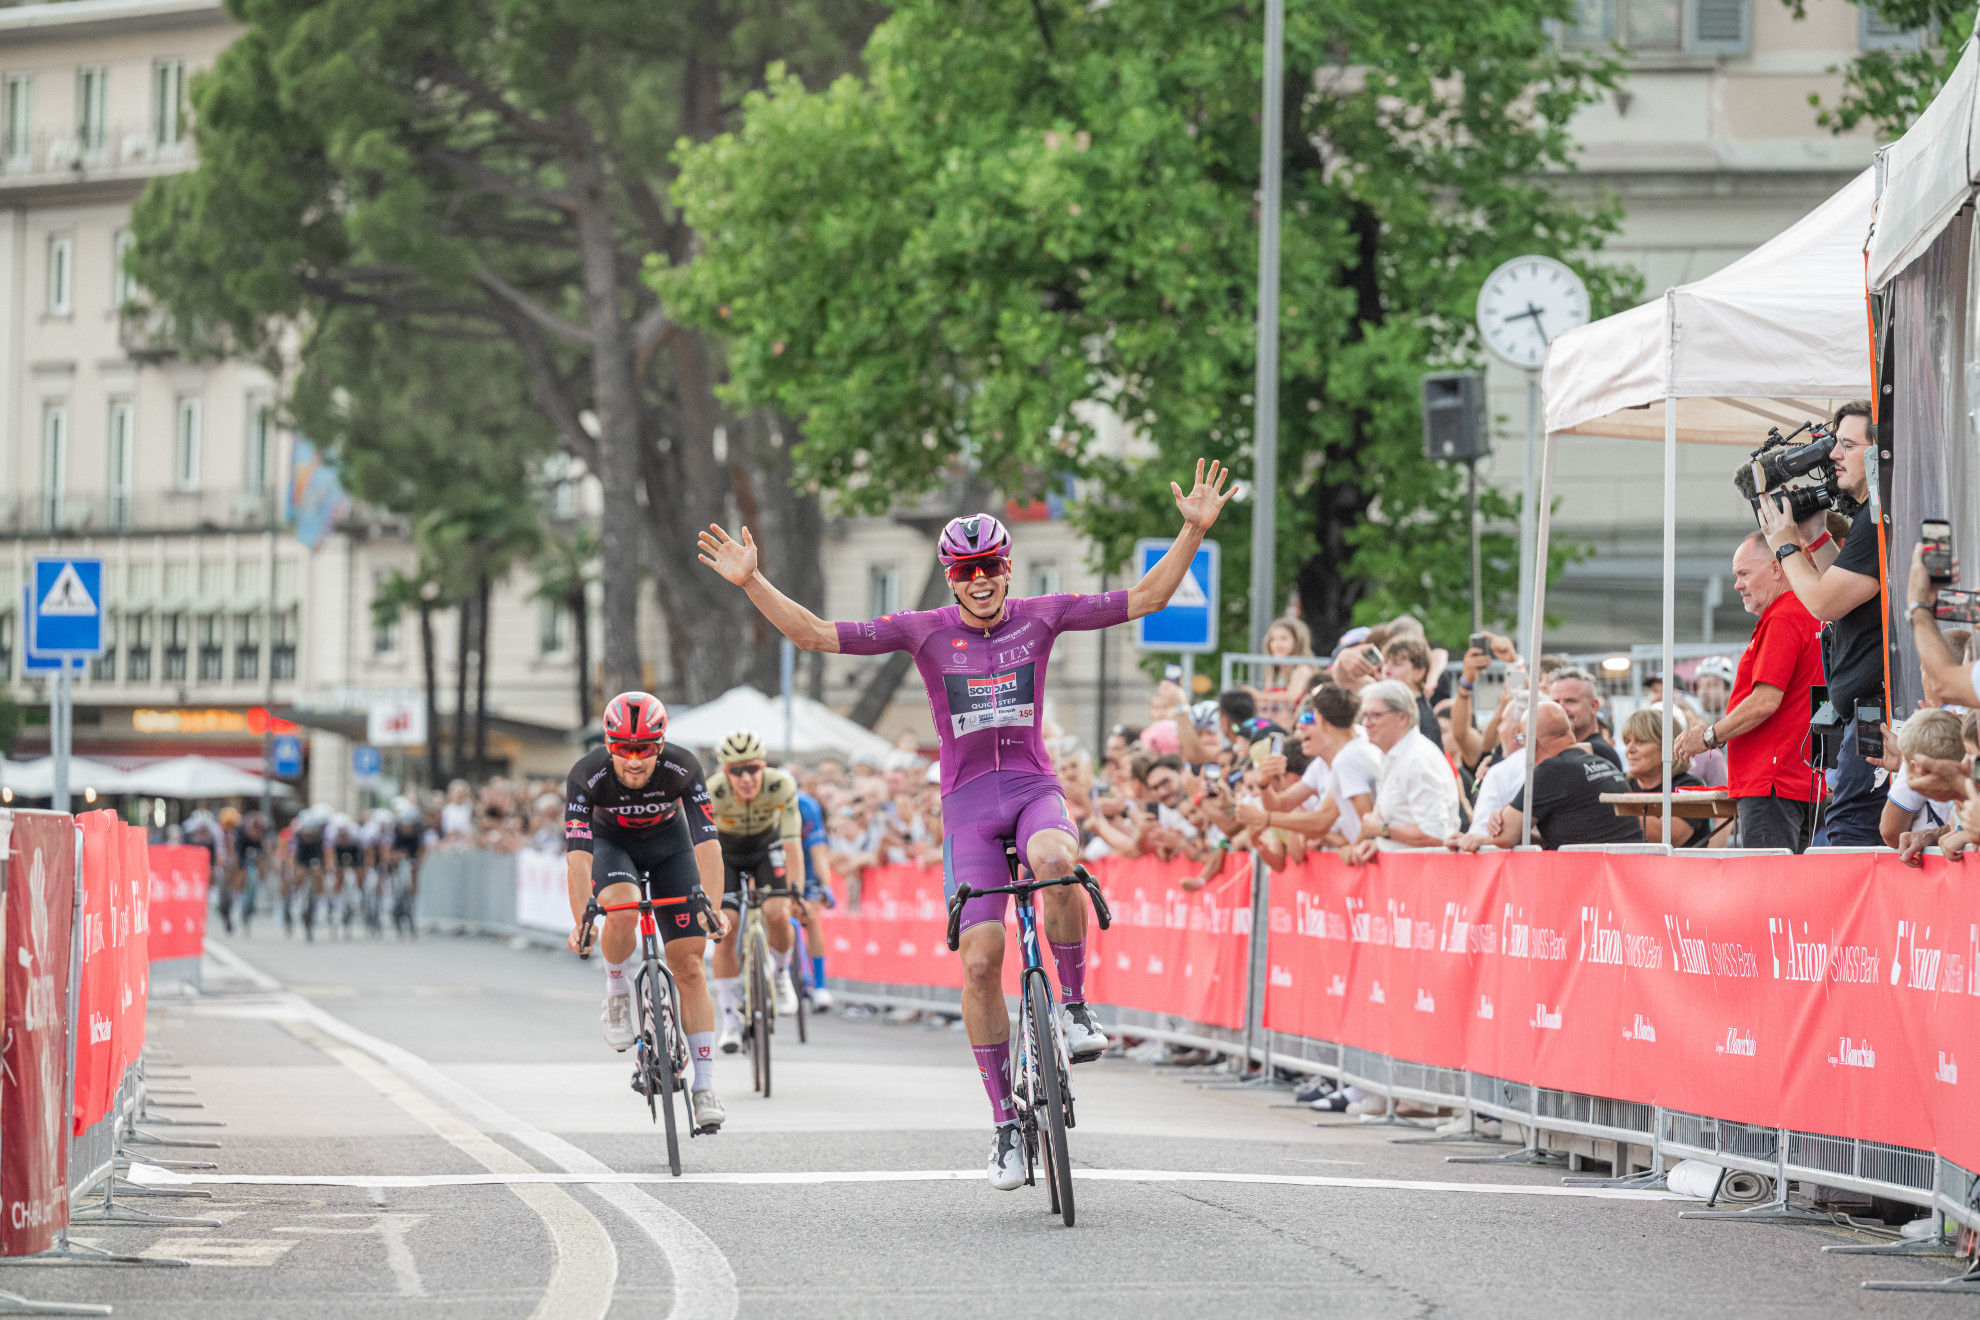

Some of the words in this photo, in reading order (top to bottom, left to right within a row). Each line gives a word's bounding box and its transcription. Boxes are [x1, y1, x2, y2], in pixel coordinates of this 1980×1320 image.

[998, 645, 1029, 664] ITA
[969, 682, 1016, 696] SOUDAL
[1019, 709, 1033, 718] 150
[588, 767, 607, 788] BMC
[664, 760, 688, 777] BMC
[568, 803, 589, 813] MSC
[1588, 907, 1623, 965] Axion
[1676, 915, 1711, 975] Axion
[1712, 942, 1738, 977] SWISS
[1737, 943, 1759, 978] Bank
[1786, 918, 1827, 982] Axion
[1831, 945, 1859, 983] SWISS
[1860, 946, 1880, 984] Bank
